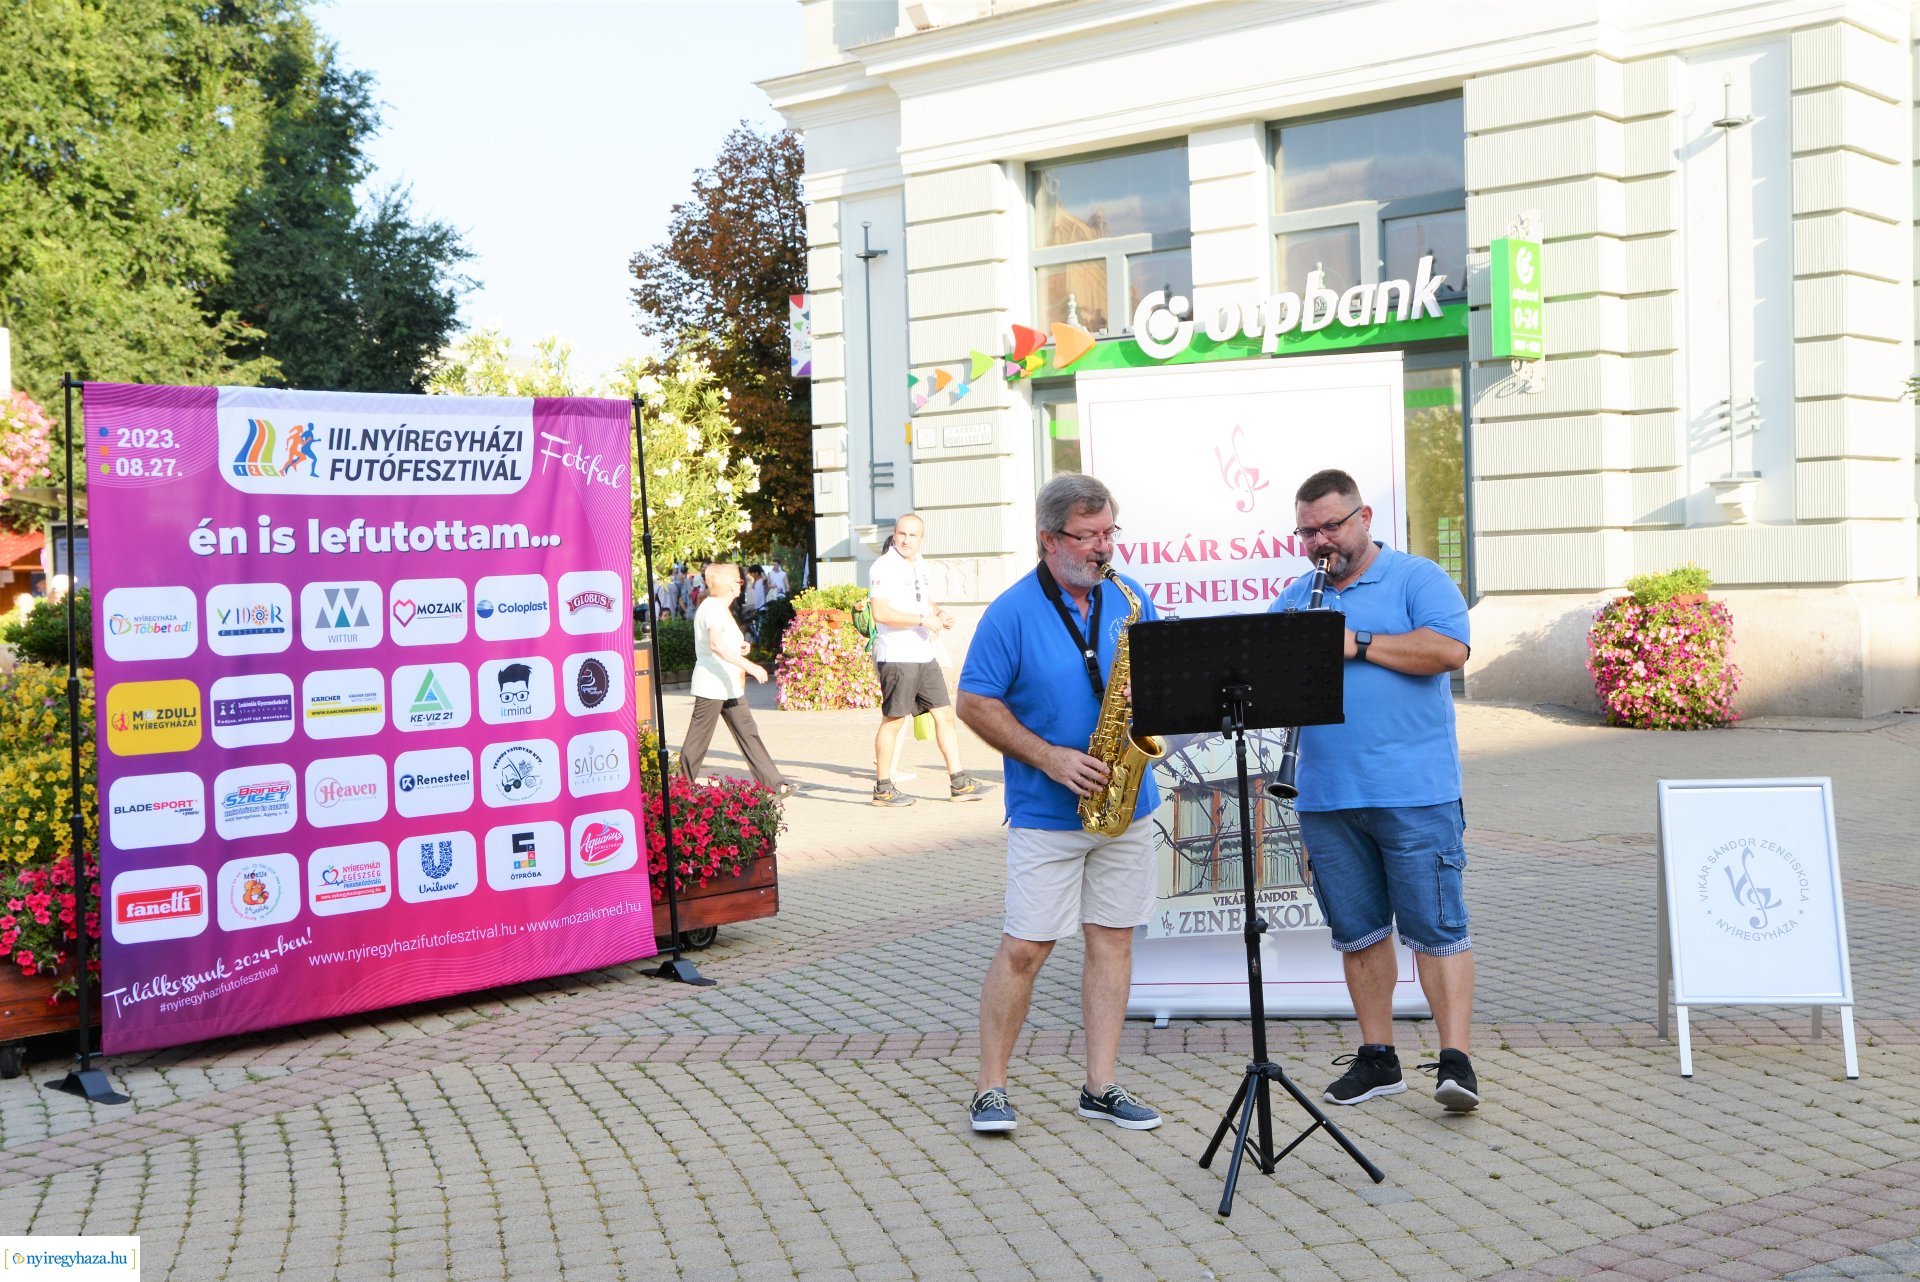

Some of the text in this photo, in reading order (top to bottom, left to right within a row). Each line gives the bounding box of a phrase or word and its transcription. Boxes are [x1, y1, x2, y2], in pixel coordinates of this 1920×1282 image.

[1204, 255, 1447, 353] otpbank
[1514, 307, 1539, 330] 0-24
[116, 427, 181, 449] 2023.
[115, 458, 183, 477] 08.27.
[329, 453, 522, 482] FUTÓFESZTIVÁL
[540, 431, 626, 489] Fotófal
[189, 515, 561, 556] én is lefutottam...
[1116, 529, 1310, 566] VIKÁR SÁN
[573, 593, 607, 607] GLOBUS
[1144, 576, 1300, 612] ZENEISK
[417, 602, 463, 615] MOZAIK
[498, 600, 548, 614] Coloplast
[133, 614, 177, 622] NYÍREGYHÁZA
[134, 621, 192, 635] Többet ad!
[328, 634, 358, 643] WITTUR
[410, 712, 453, 723] KE-VIZ 21
[501, 705, 532, 717] itmind
[133, 719, 197, 731] NYÍREGYHÁZA!
[574, 746, 619, 778] SAJGÓ
[416, 770, 470, 786] Renesteel
[225, 791, 287, 807] SZIGET
[320, 780, 377, 804] Heaven
[114, 799, 194, 815] BLADESPORT
[342, 861, 381, 873] NYÍREGYHÁZI
[343, 869, 381, 882] EGÉSZSÉG
[510, 870, 542, 880] ÖTPRÓBA
[1697, 837, 1810, 903] VIKÁR SÁNDOR ZENEISKOLA
[419, 881, 459, 894] Unilever
[1254, 890, 1299, 904] ÁNDOR
[126, 891, 191, 918] fanelli
[1179, 902, 1328, 935] ZENESKOL
[308, 899, 642, 967] www.nyiregyhazifutofesztival.hu www.mozaikmed.hu
[1715, 918, 1799, 942] NYÍREGYHÁZA
[102, 926, 313, 1019] Találkozzunk 2024-ben!
[159, 963, 279, 1014] #nyiregyhazifutofesztival
